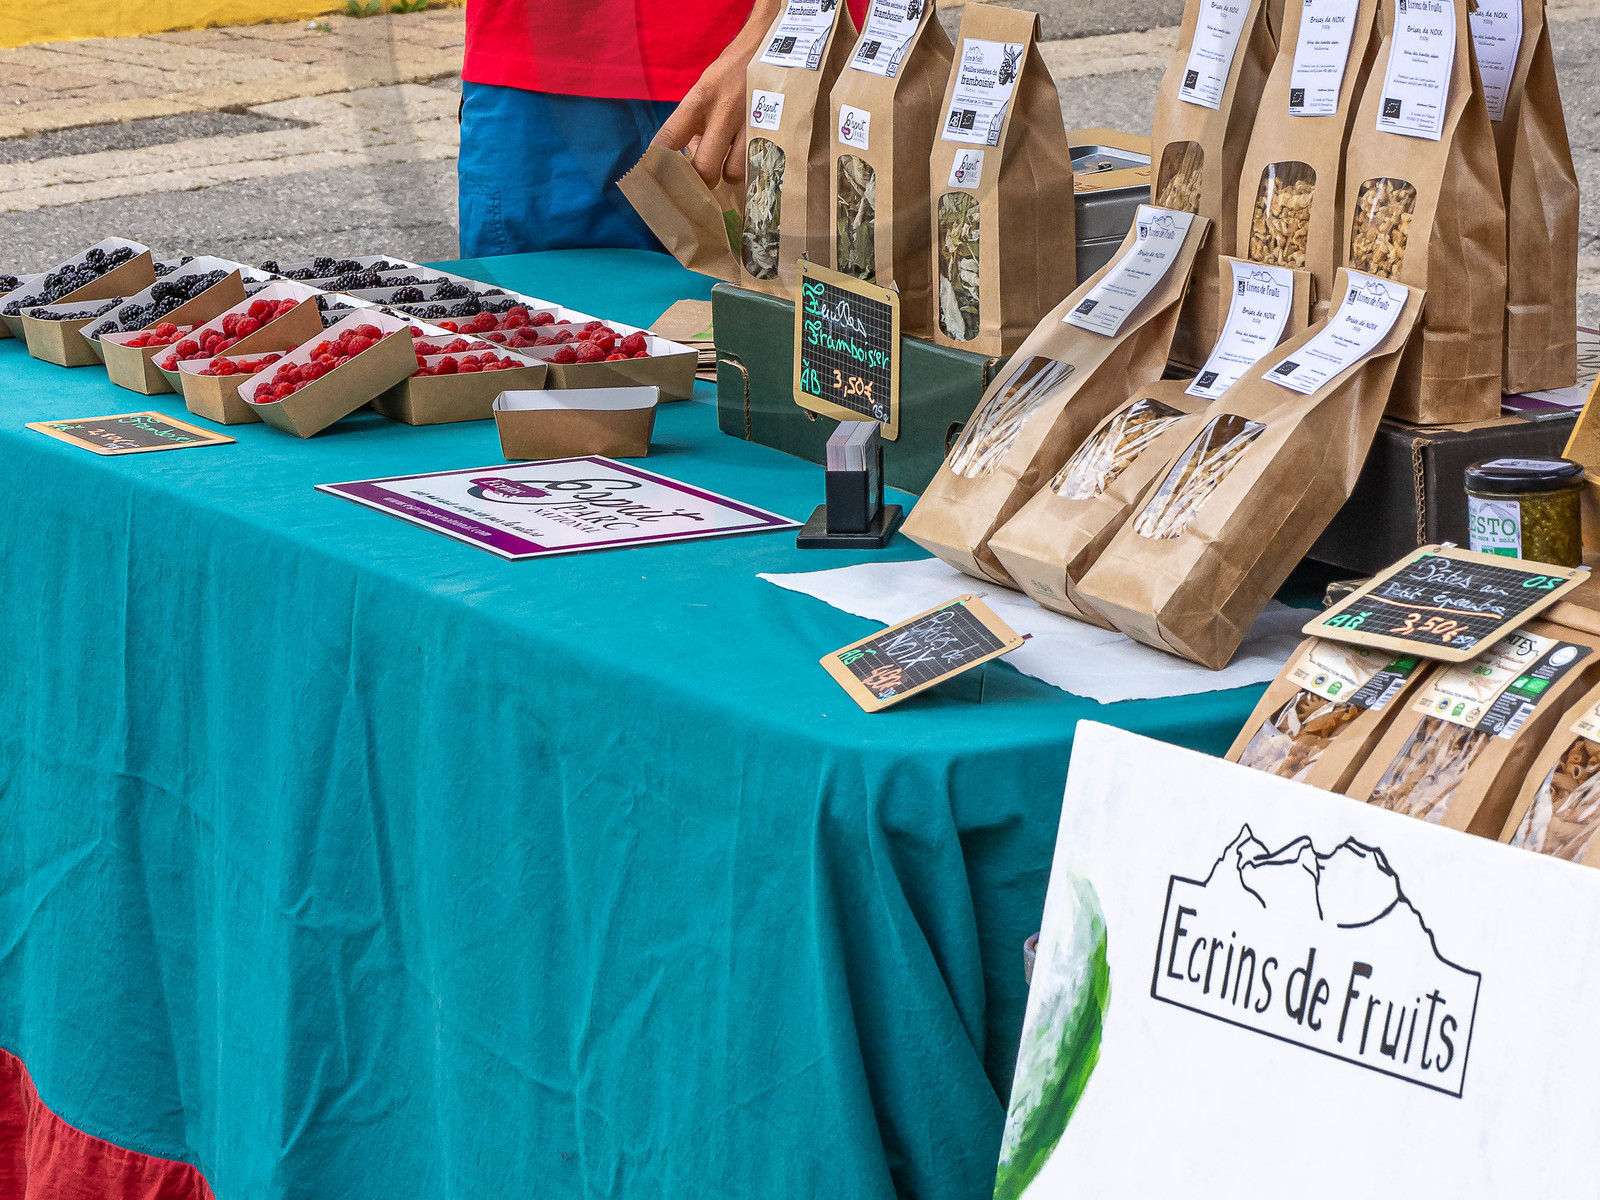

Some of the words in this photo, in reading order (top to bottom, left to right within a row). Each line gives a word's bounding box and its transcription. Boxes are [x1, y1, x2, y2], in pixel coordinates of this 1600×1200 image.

[833, 370, 874, 403] 3,50€
[505, 478, 705, 522] Esprit
[527, 508, 600, 533] NATIONAL
[554, 504, 640, 531] PARC
[1166, 905, 1278, 1013] Ecrins
[1285, 947, 1329, 1031] de
[1337, 961, 1458, 1073] Fruits
